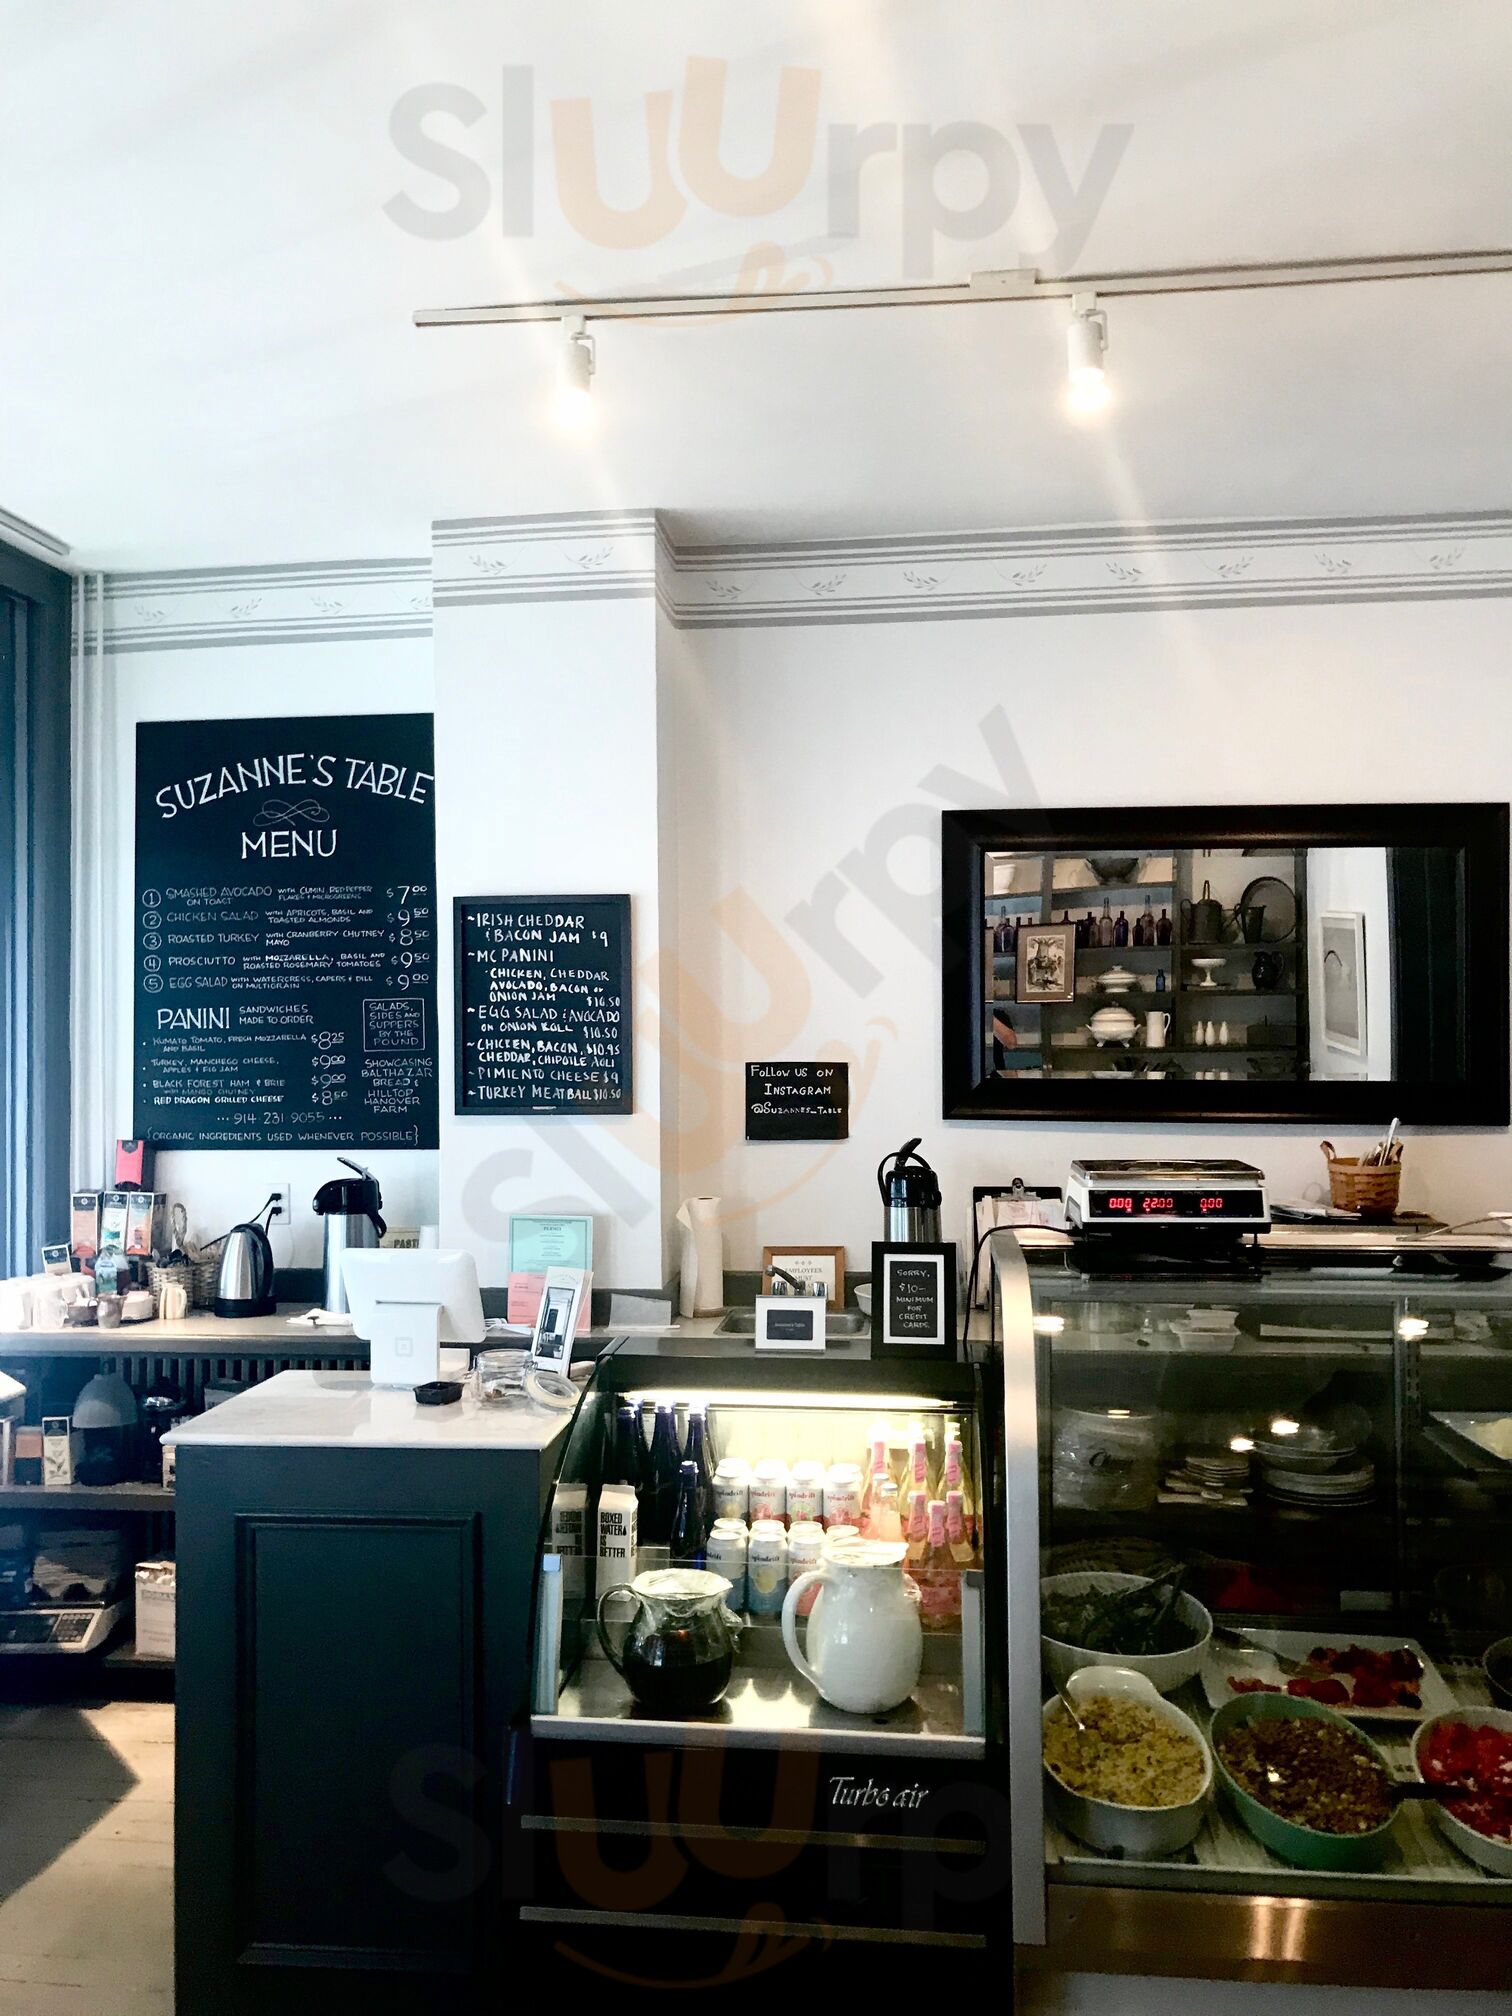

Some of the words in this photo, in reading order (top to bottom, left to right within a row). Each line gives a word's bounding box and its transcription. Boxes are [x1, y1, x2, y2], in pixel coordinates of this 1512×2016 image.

[156, 753, 336, 818] SUZANNE'S
[345, 757, 435, 804] TABLE
[241, 829, 337, 859] MENU
[166, 887, 216, 899] SMASHED
[221, 886, 272, 896] AVOCADO
[167, 912, 217, 922] CHICKEN
[220, 911, 259, 921] SALAD
[477, 913, 513, 927] IRISH
[518, 914, 585, 929] CHEDDAR
[168, 933, 215, 944] ROASTED
[217, 933, 260, 943] TURKEY
[266, 939, 290, 947] MAYO
[494, 929, 543, 943] BACON
[549, 931, 580, 944] JAM
[592, 931, 609, 947] $9
[168, 956, 236, 966] PROSCIUTTO
[501, 948, 554, 963] PANINI
[243, 961, 281, 970] ROASTED
[336, 960, 382, 968] TOMATOES
[550, 968, 610, 981] CHEDDAR
[169, 976, 192, 989] EGG
[195, 976, 228, 987] SALAD
[550, 982, 589, 994] BACON
[489, 991, 528, 1003] ONION
[532, 992, 556, 1002] JAM
[157, 1007, 230, 1030] PANINI
[239, 1004, 309, 1014] SANDWICHES
[369, 1011, 402, 1020] SIDES
[478, 1005, 511, 1019] EGG
[515, 1007, 558, 1020] SALAD
[569, 1009, 620, 1023] AVOCADO
[239, 1016, 264, 1025] MADE
[369, 1020, 419, 1029] SUPPERS
[500, 1021, 538, 1032] ONION
[254, 1033, 307, 1042] MOZZARELLA
[379, 1030, 392, 1038] BY
[373, 1037, 419, 1046] POUND
[365, 1058, 433, 1068] SHOWCASING
[361, 1068, 433, 1078] BALTHAZAR
[478, 1067, 545, 1080] PIMIENTO
[550, 1070, 600, 1082] CHEESE
[603, 1071, 619, 1084] $9
[153, 1080, 183, 1088] BLACK
[187, 1079, 224, 1088] FOREST
[230, 1079, 250, 1087] HAM
[264, 1079, 286, 1087] BRIE
[373, 1078, 411, 1087] BREAD
[368, 1088, 414, 1098] HILLTOP
[478, 1085, 526, 1099] TURKEY
[154, 1096, 172, 1105] RED
[174, 1096, 210, 1104] DRAGON
[214, 1096, 248, 1104] GRILLED
[251, 1095, 285, 1103] CHEESE
[364, 1097, 421, 1105] HANOVER
[373, 1105, 408, 1113] FARM
[234, 1112, 257, 1125] 914
[263, 1112, 284, 1125] 231
[291, 1111, 325, 1124] 9055
[199, 1131, 262, 1141] INGREDIENTS
[267, 1132, 293, 1141] USED
[298, 1131, 354, 1141] WHENEVER
[1109, 1198, 1132, 1209] 0.00
[1143, 1198, 1173, 1209] 22.00
[1200, 1198, 1223, 1209] 0.00
[896, 1296, 934, 1304] MINIMUM
[600, 1511, 623, 1524] BOXED
[600, 1547, 626, 1558] BETTER
[830, 1777, 890, 1807] Turbo
[892, 1783, 929, 1809] air
